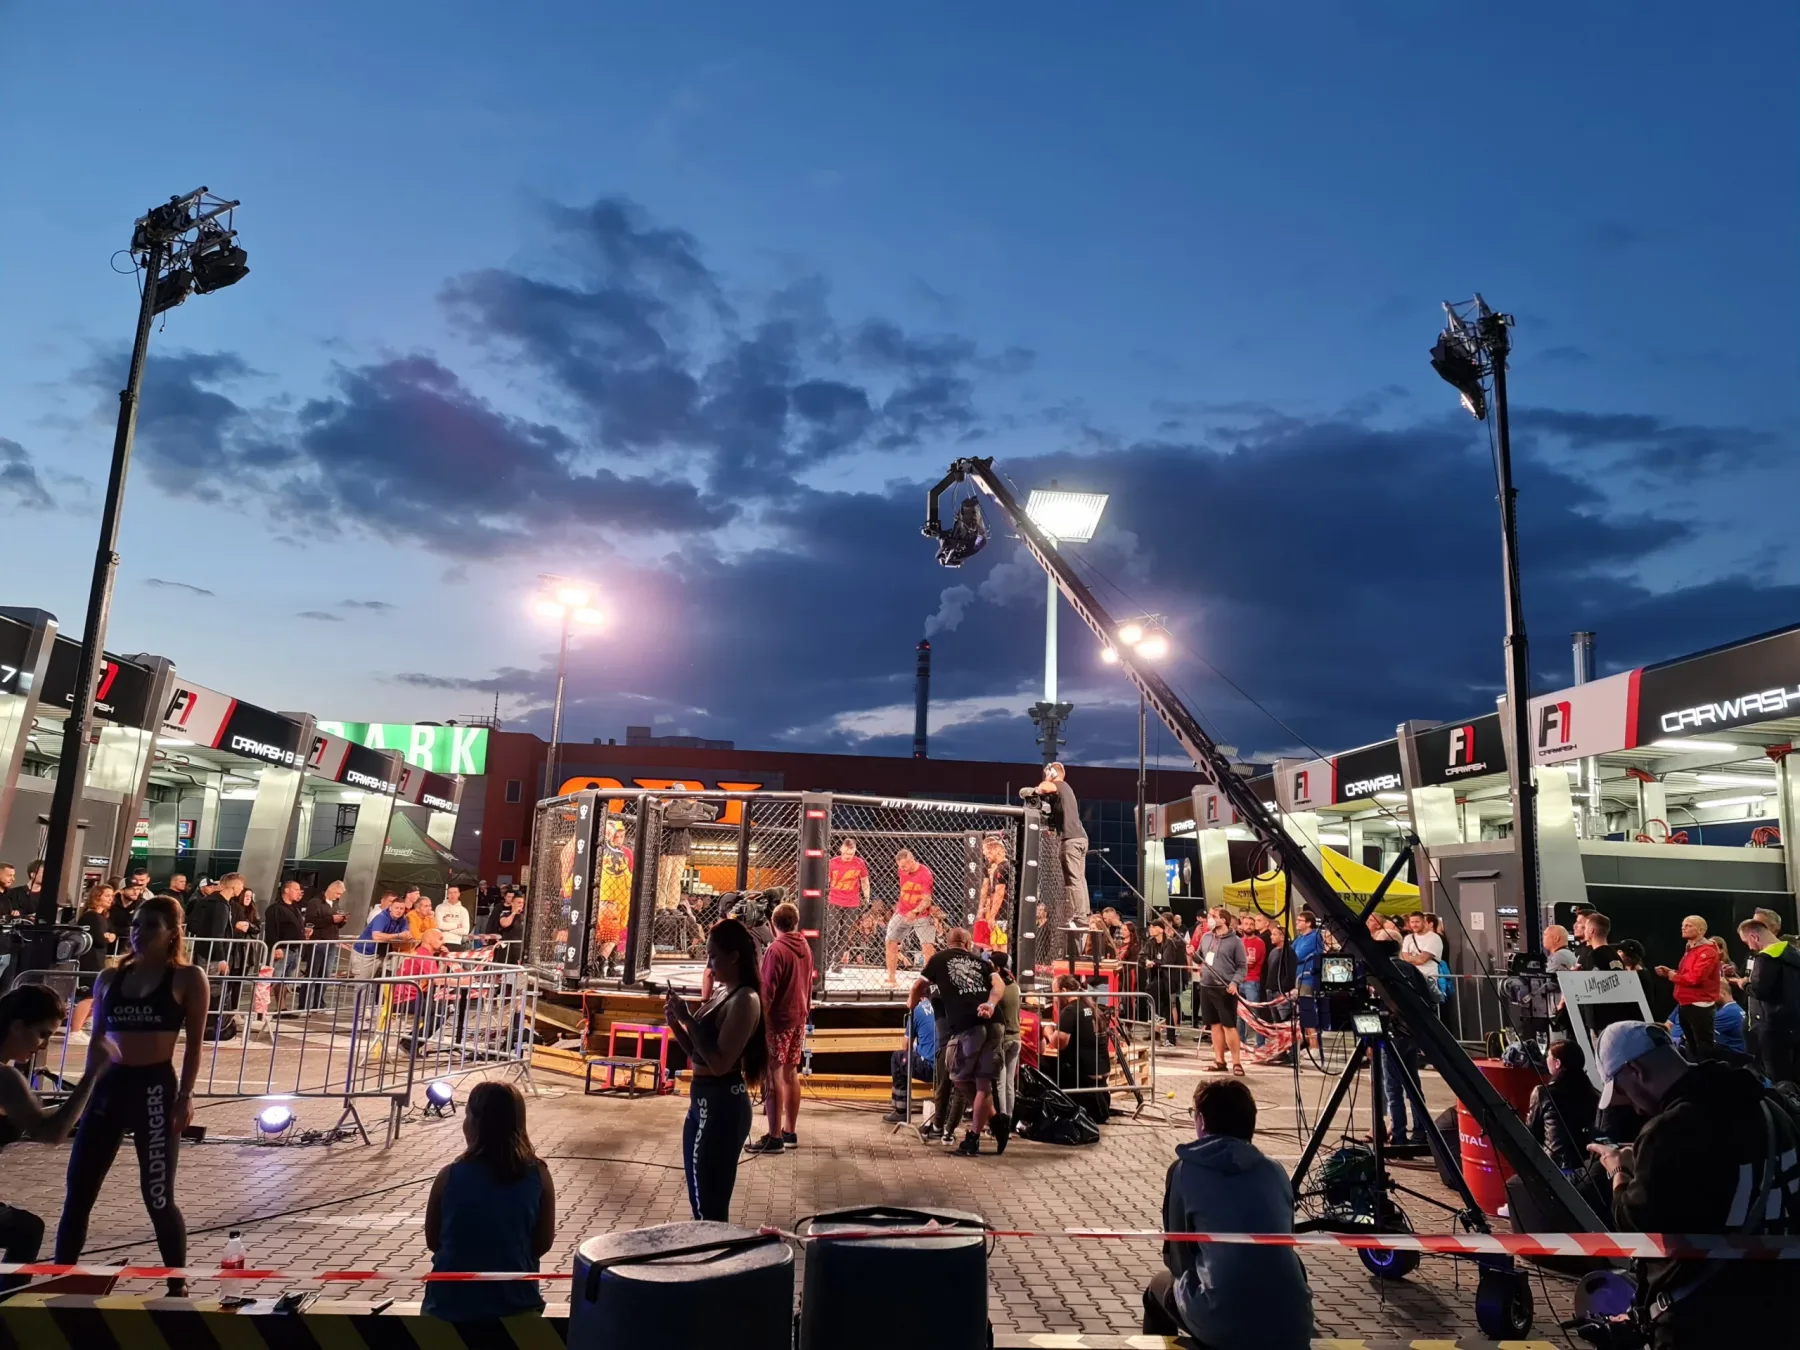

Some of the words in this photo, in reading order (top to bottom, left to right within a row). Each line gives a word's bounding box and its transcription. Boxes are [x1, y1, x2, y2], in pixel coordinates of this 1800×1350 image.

[163, 688, 198, 726] F1
[1661, 684, 1800, 733] CARWASH
[1538, 701, 1571, 748] F1
[231, 735, 285, 762] CARWASH
[1449, 725, 1475, 766] F1
[347, 770, 381, 789] CARWASH
[1445, 762, 1487, 776] CARWASH
[1294, 770, 1308, 801] F1
[1345, 773, 1401, 797] CARWASH
[881, 800, 906, 808] MUAY
[911, 801, 933, 811] THAI
[937, 803, 980, 814] ACADEMY
[113, 1005, 153, 1015] GOLD
[147, 1084, 167, 1210] GOLDFINGERS
